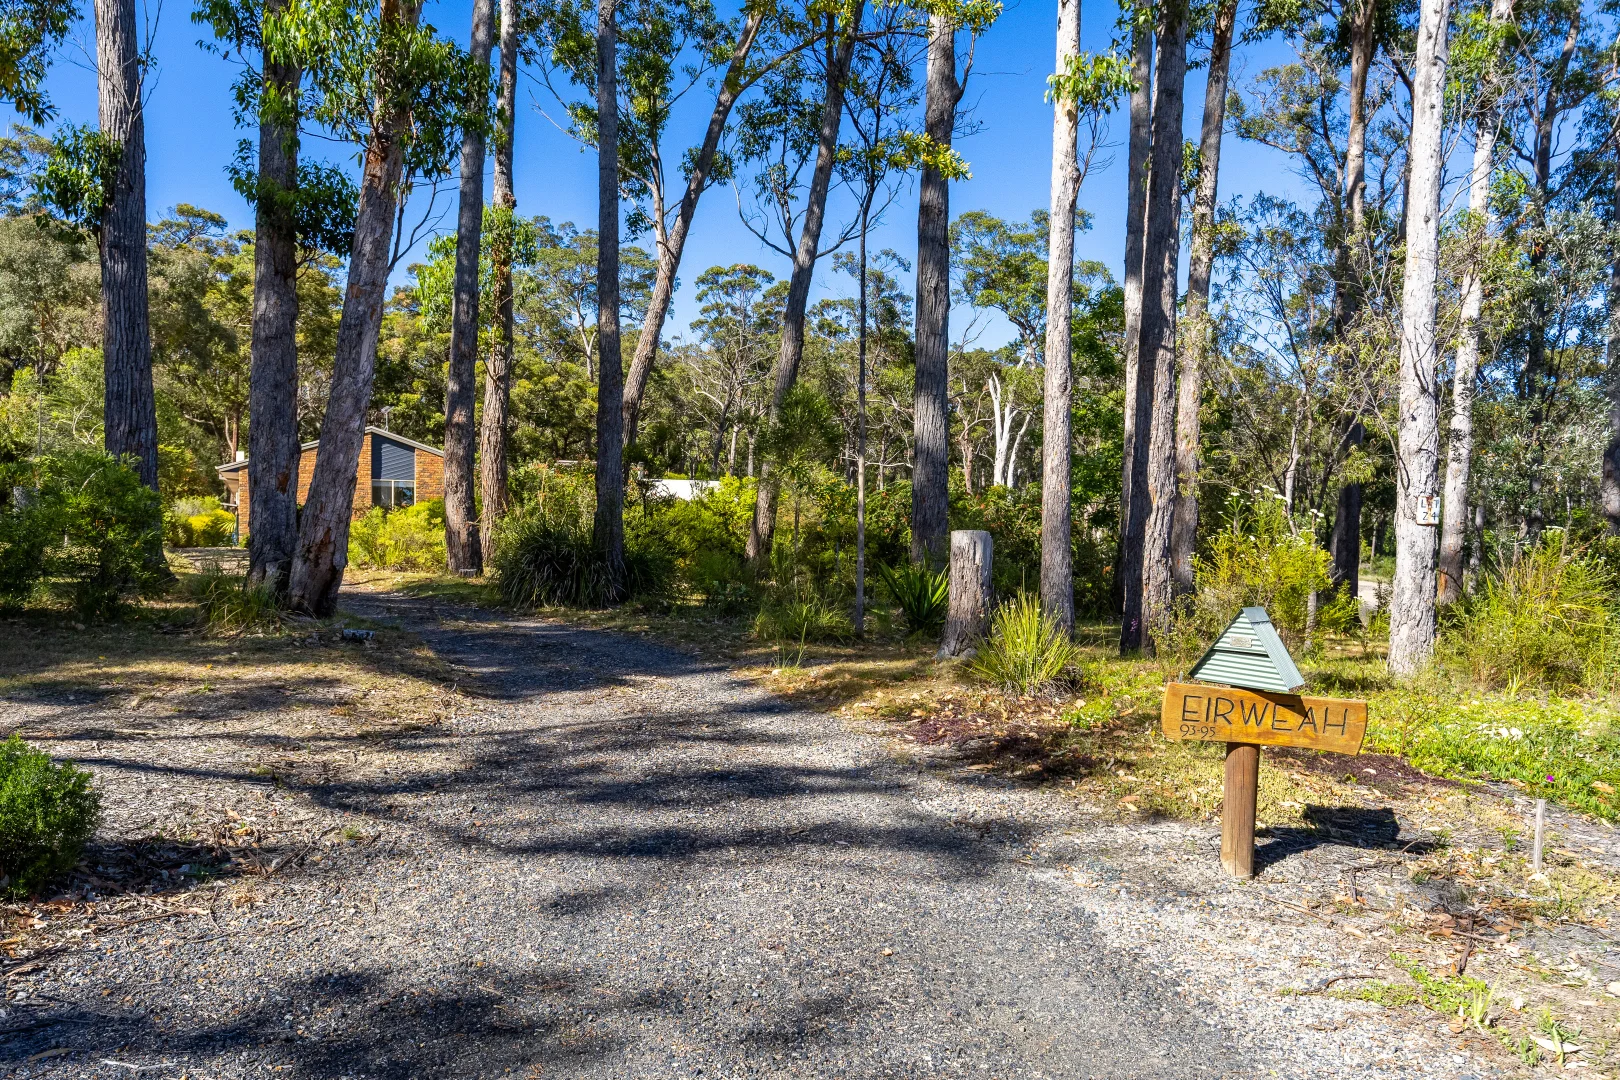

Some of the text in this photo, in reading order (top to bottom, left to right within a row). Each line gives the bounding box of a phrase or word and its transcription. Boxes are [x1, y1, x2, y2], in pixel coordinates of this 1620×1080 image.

[1420, 499, 1439, 509] LT
[1181, 694, 1348, 736] EIRWEAH
[1179, 723, 1216, 739] 93-95
